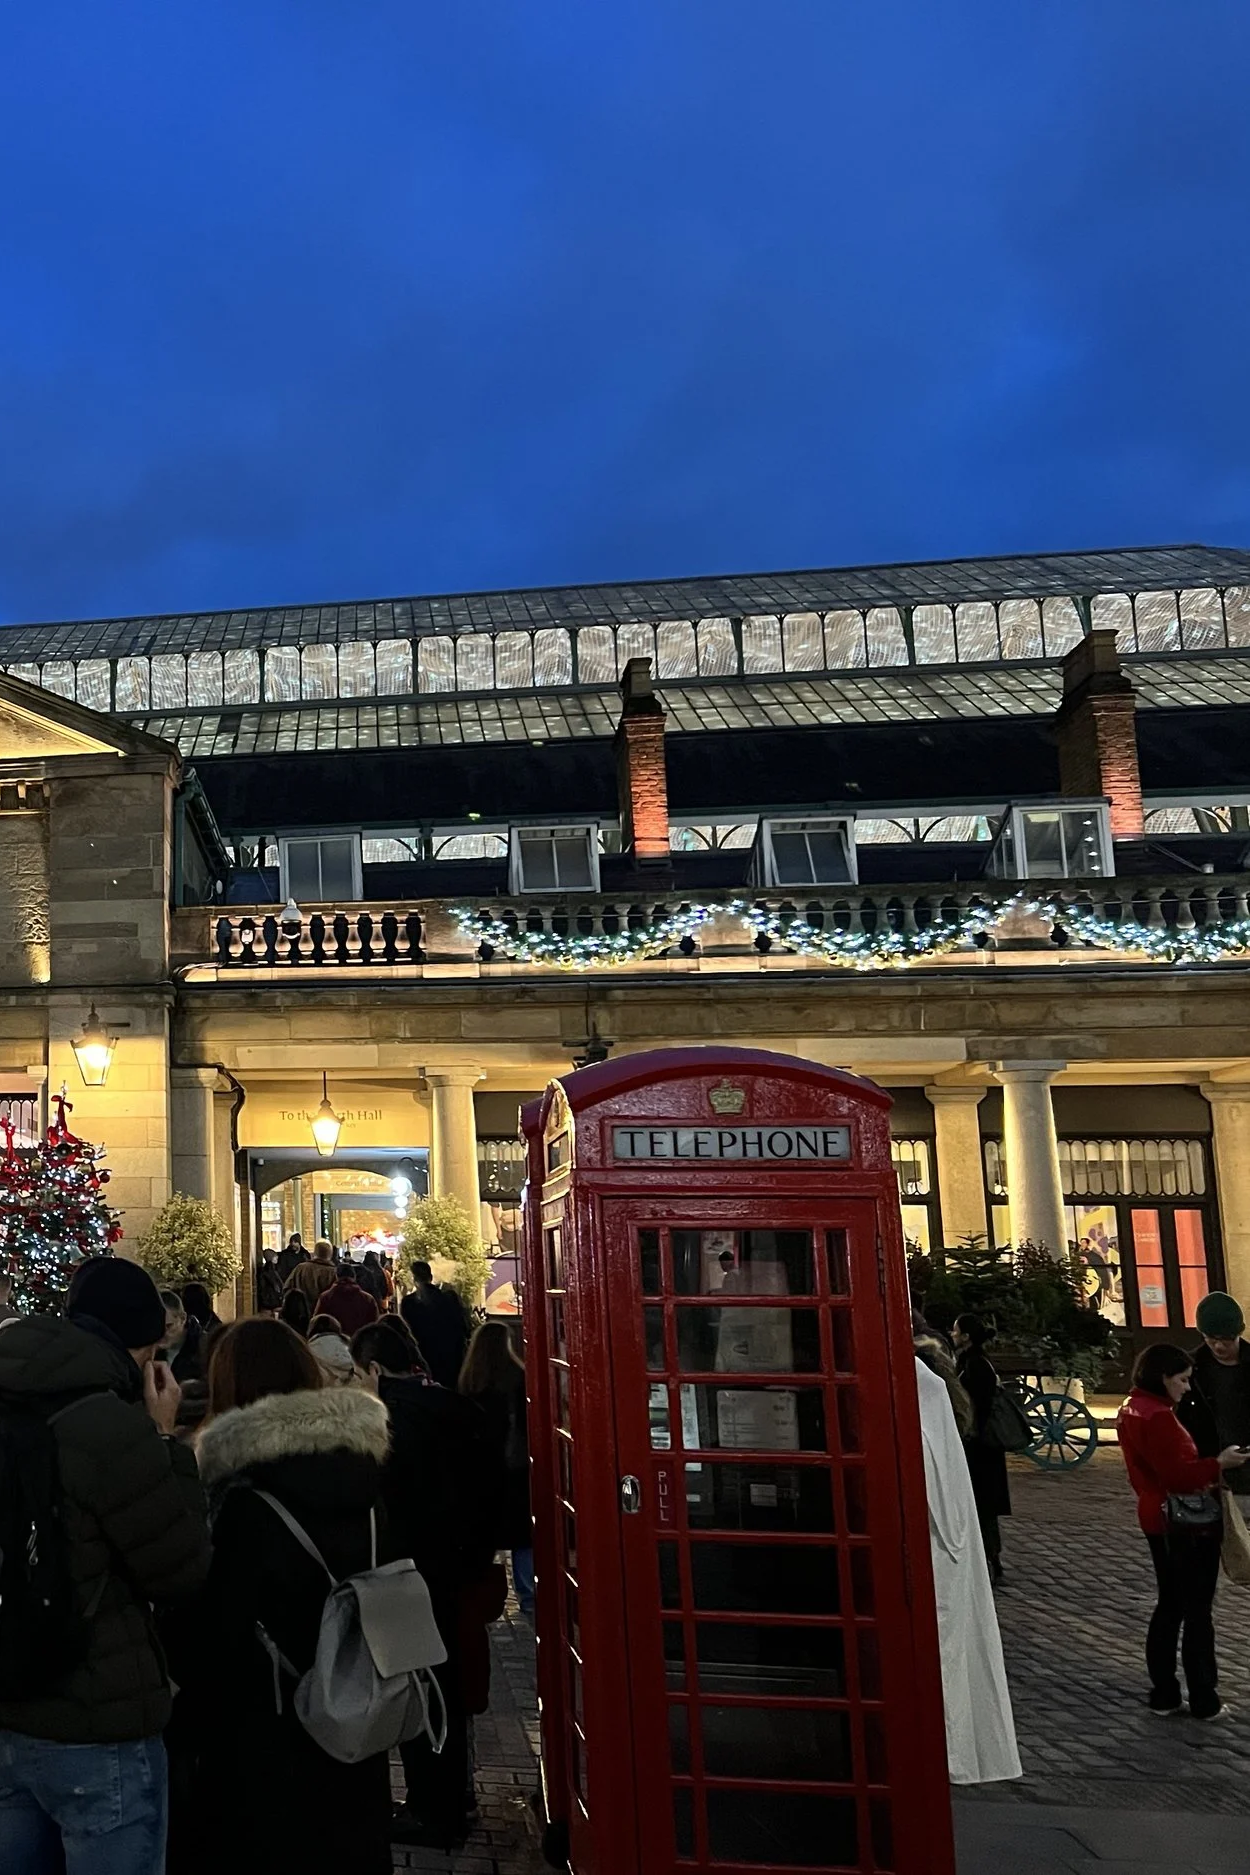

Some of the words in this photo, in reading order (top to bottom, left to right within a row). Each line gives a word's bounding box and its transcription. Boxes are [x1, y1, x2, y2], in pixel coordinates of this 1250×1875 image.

[279, 1110, 294, 1121] To
[357, 1109, 382, 1121] Hall
[620, 1131, 841, 1158] TELEPHONE
[658, 1471, 669, 1521] PULL
